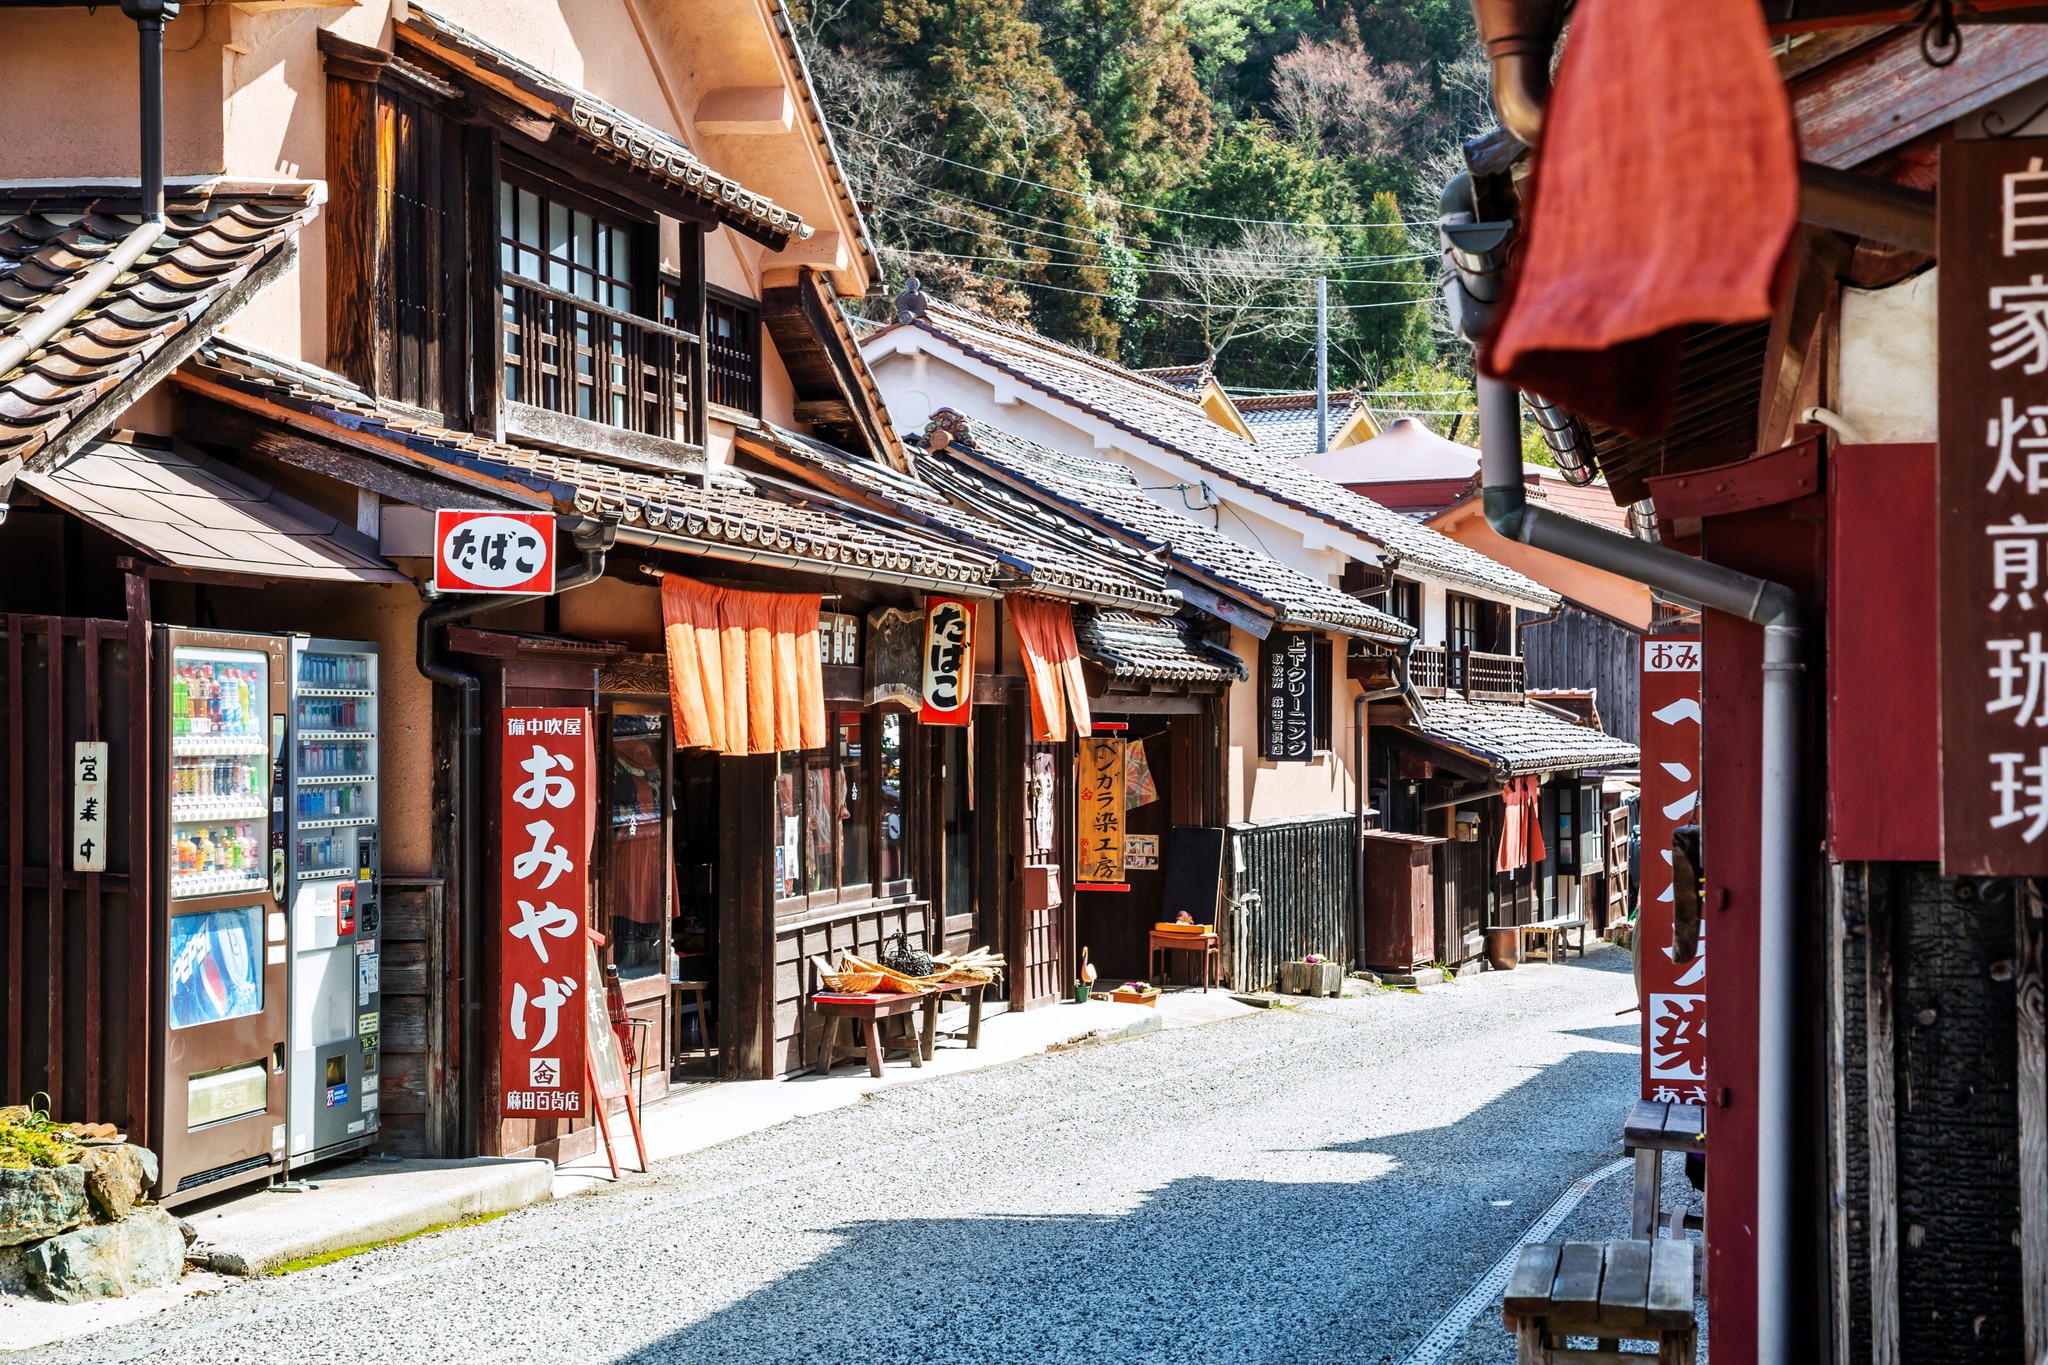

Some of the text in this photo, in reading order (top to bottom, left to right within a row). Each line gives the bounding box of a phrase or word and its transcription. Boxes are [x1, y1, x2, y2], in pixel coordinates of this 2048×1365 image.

[452, 528, 537, 573] たばこ
[931, 606, 971, 708] たばこ
[1287, 635, 1307, 756] 上下クリーニング
[507, 718, 582, 736] 備中吹屋
[79, 755, 99, 863] 営業中
[1092, 740, 1121, 878] ベンガラ染工房
[509, 744, 579, 1053] おみやげ
[172, 916, 211, 997] PEPSI
[507, 1090, 580, 1111] 麻田百貨店
